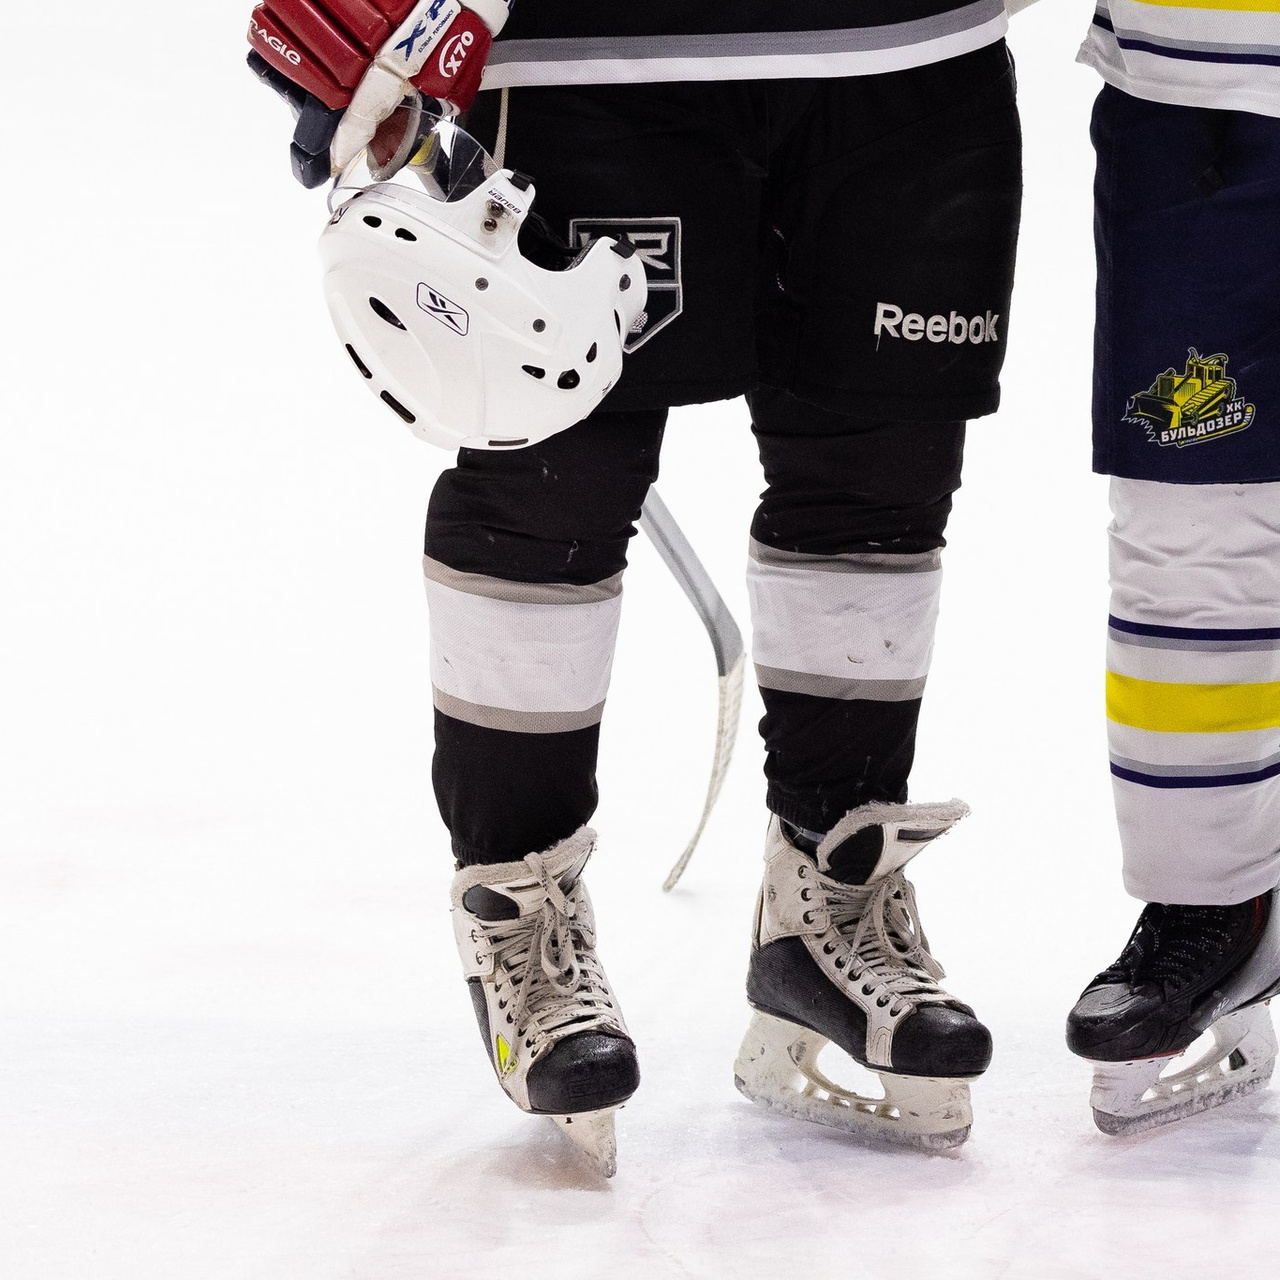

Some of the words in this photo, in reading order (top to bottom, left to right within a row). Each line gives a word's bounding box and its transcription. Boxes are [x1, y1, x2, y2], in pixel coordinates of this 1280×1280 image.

[874, 302, 999, 345] Reebok
[1226, 400, 1243, 414] ХК
[1161, 412, 1243, 442] БУЛЬДОЗЕР
